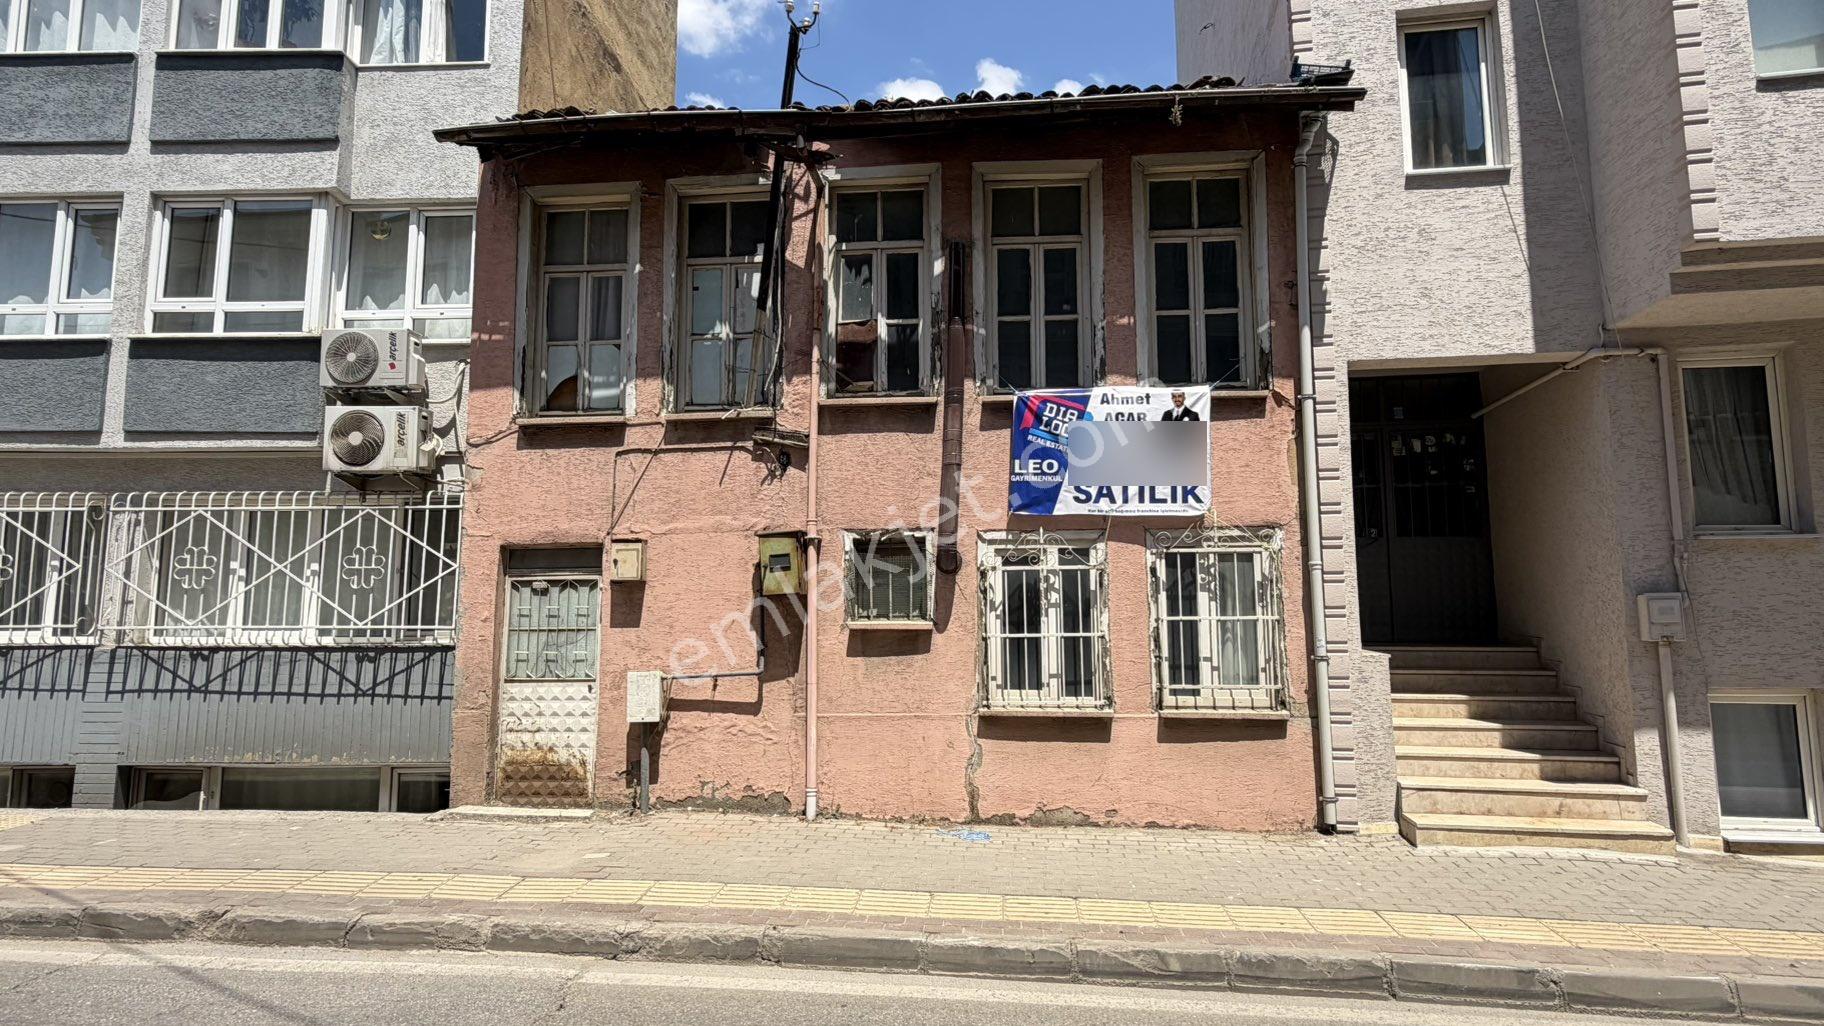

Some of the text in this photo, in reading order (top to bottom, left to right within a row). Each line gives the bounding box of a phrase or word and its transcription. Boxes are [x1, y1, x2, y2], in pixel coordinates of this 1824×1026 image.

[389, 331, 397, 360] arçelik
[1100, 393, 1151, 405] Ahmet
[1043, 402, 1078, 421] DIA
[1027, 434, 1068, 454] REAL ESTAT
[1014, 459, 1059, 473] LEO
